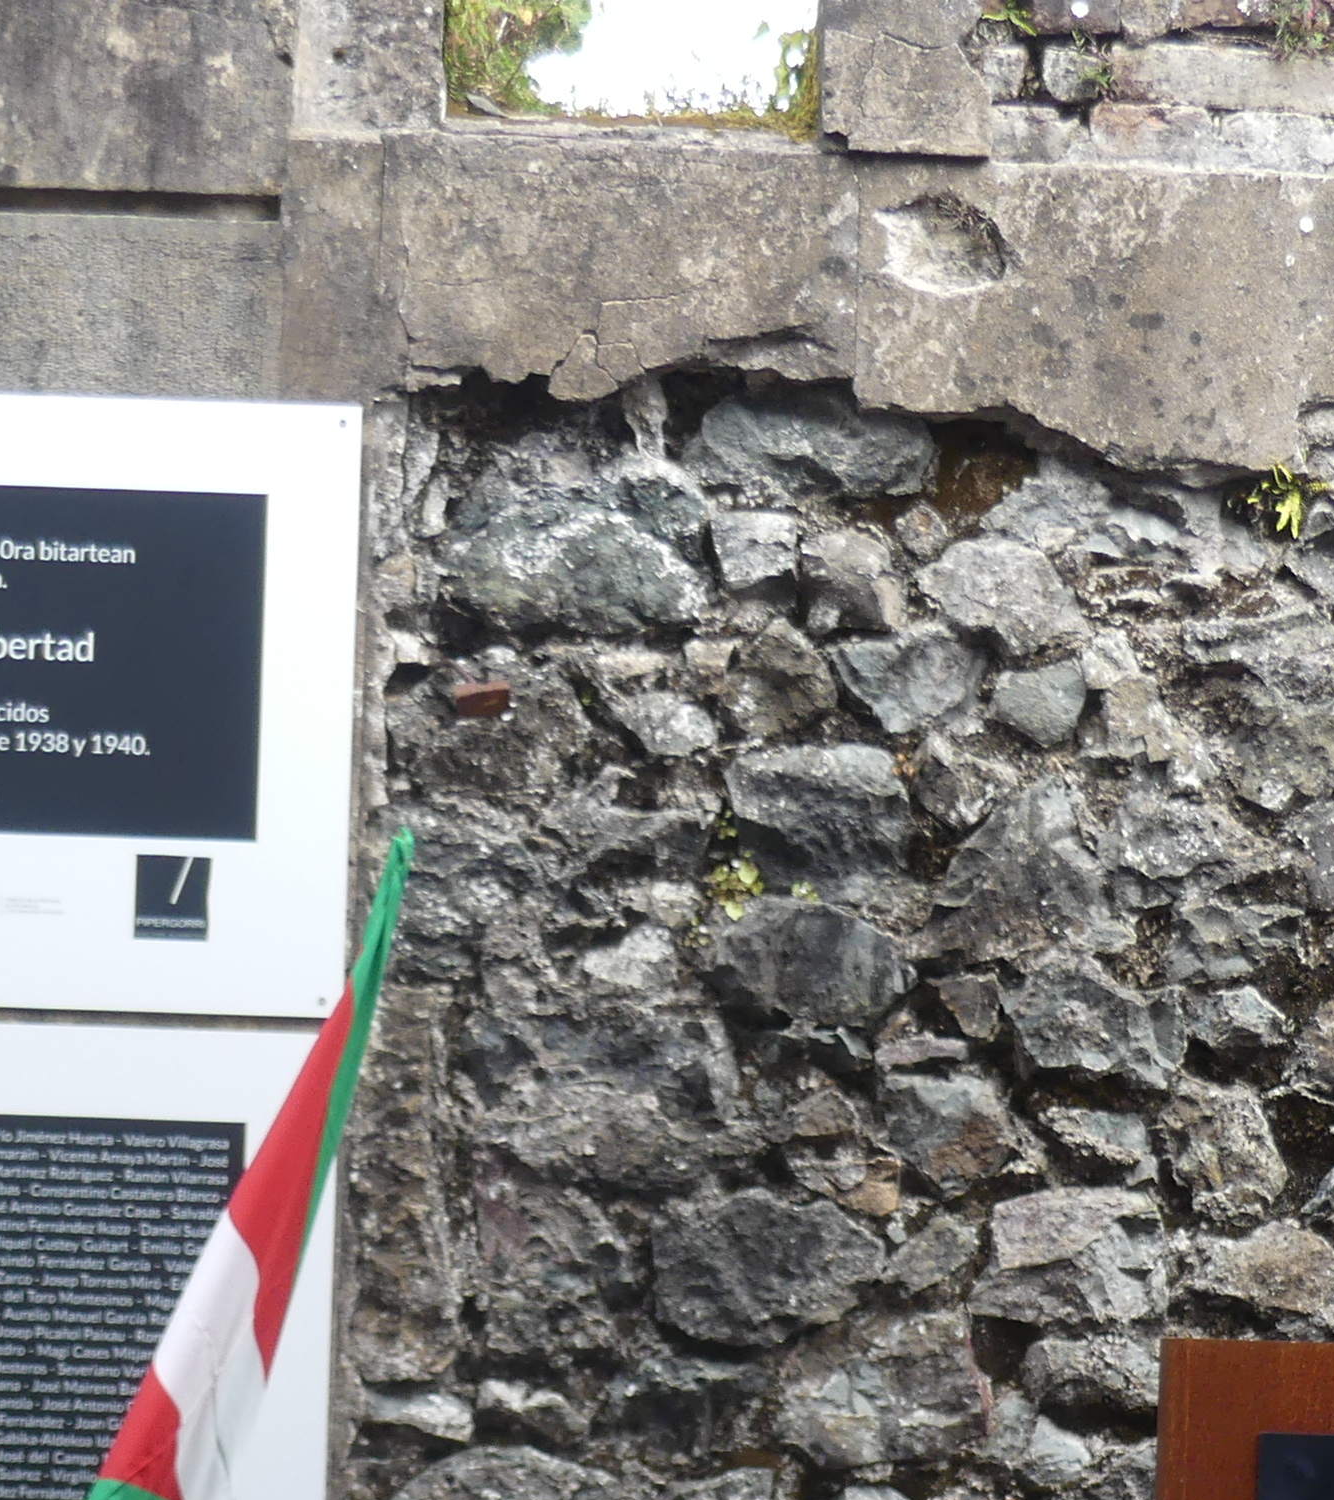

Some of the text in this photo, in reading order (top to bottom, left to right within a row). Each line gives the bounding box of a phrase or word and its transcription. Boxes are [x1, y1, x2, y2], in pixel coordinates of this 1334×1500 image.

[39, 541, 135, 564] bitartean
[14, 731, 68, 753] 1938
[72, 738, 85, 757] y
[91, 734, 150, 756] 1940.
